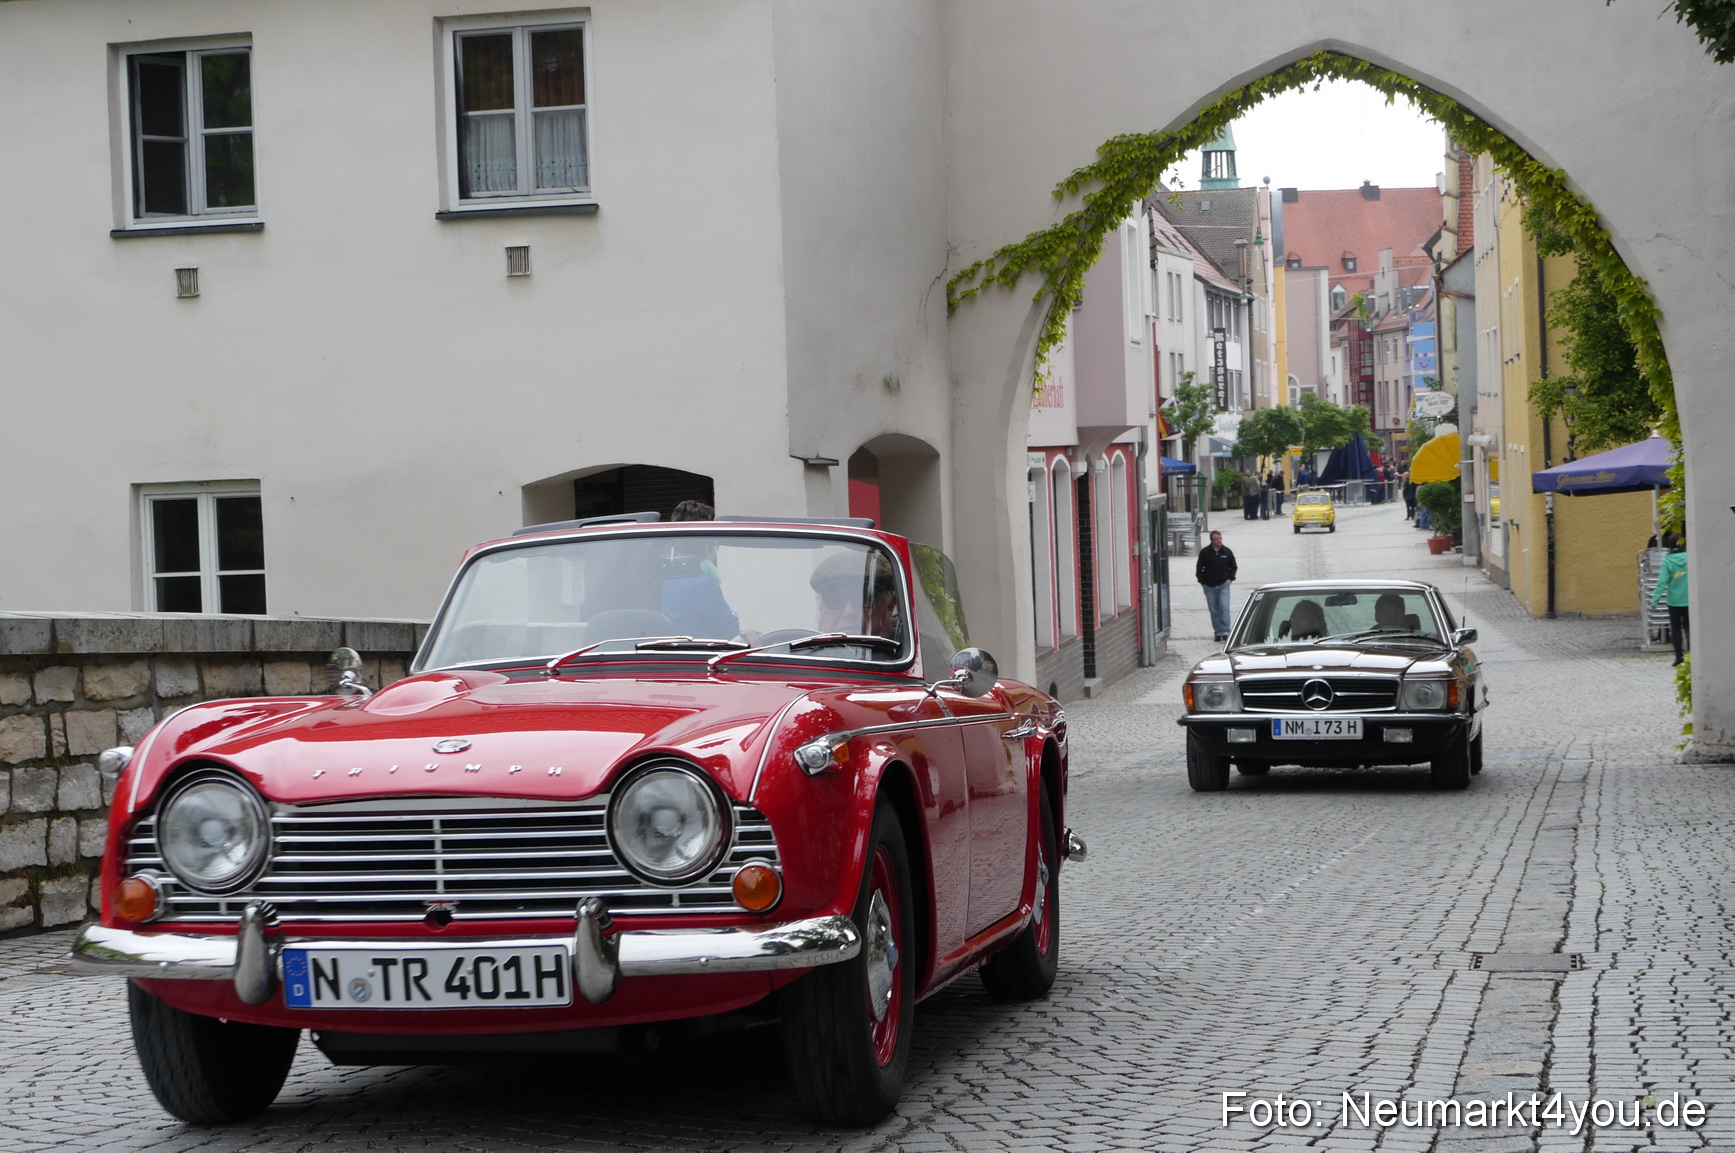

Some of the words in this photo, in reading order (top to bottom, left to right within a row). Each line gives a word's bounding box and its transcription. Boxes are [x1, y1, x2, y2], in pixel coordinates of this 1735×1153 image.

[1285, 721, 1304, 734] NM
[312, 762, 563, 779] TRIUMPH
[311, 957, 341, 1001] N
[371, 957, 432, 1001] TR
[444, 953, 565, 1000] 401H
